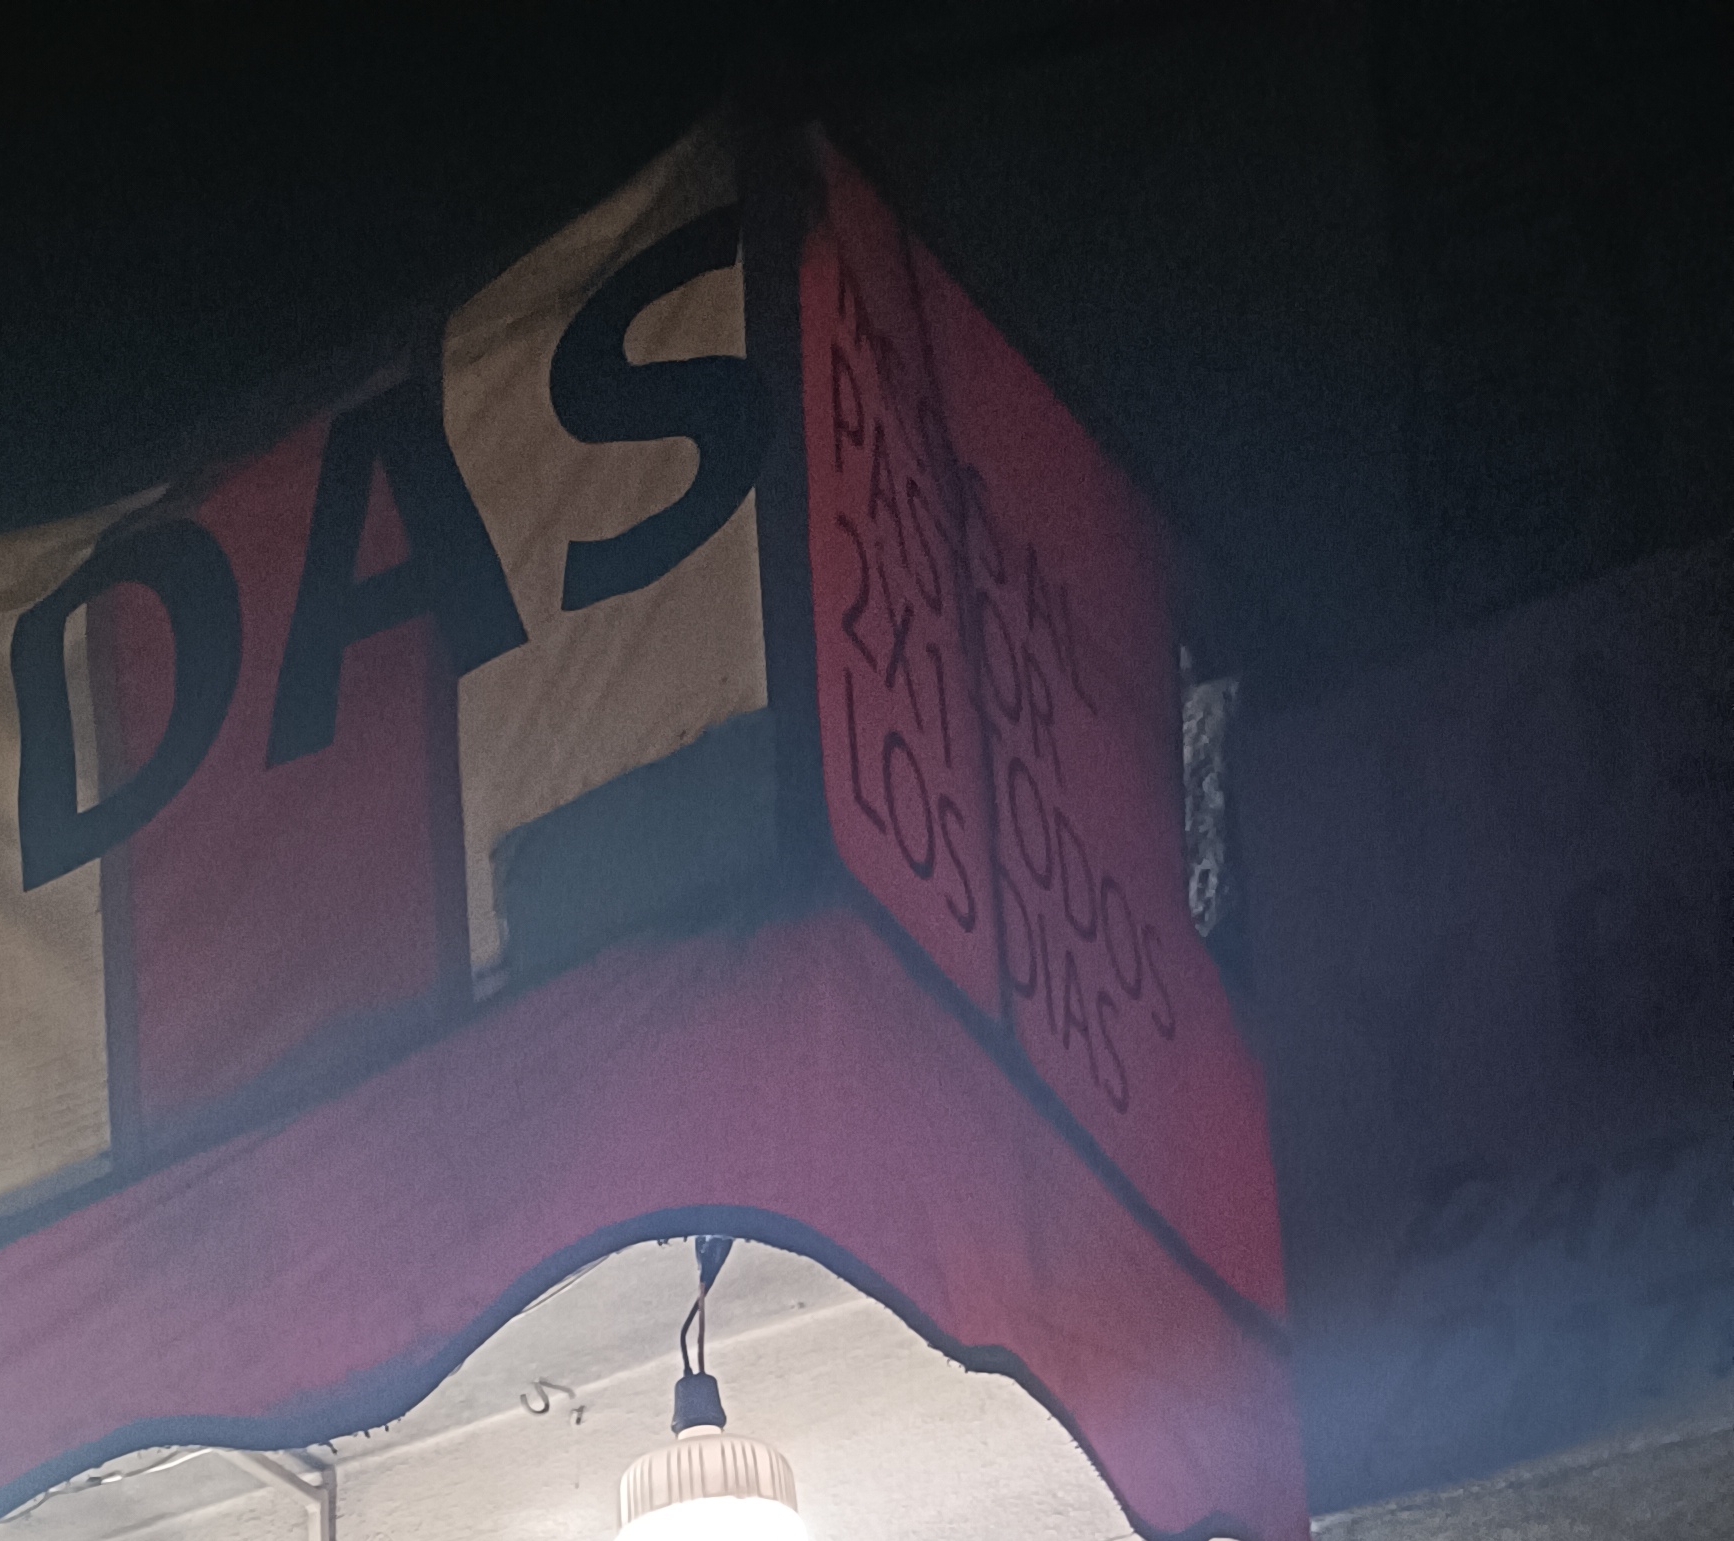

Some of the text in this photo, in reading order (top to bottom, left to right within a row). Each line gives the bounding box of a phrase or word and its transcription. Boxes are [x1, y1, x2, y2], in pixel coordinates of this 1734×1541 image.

[836, 512, 953, 770] 2X1
[845, 664, 1130, 1115] LOS DIAS
